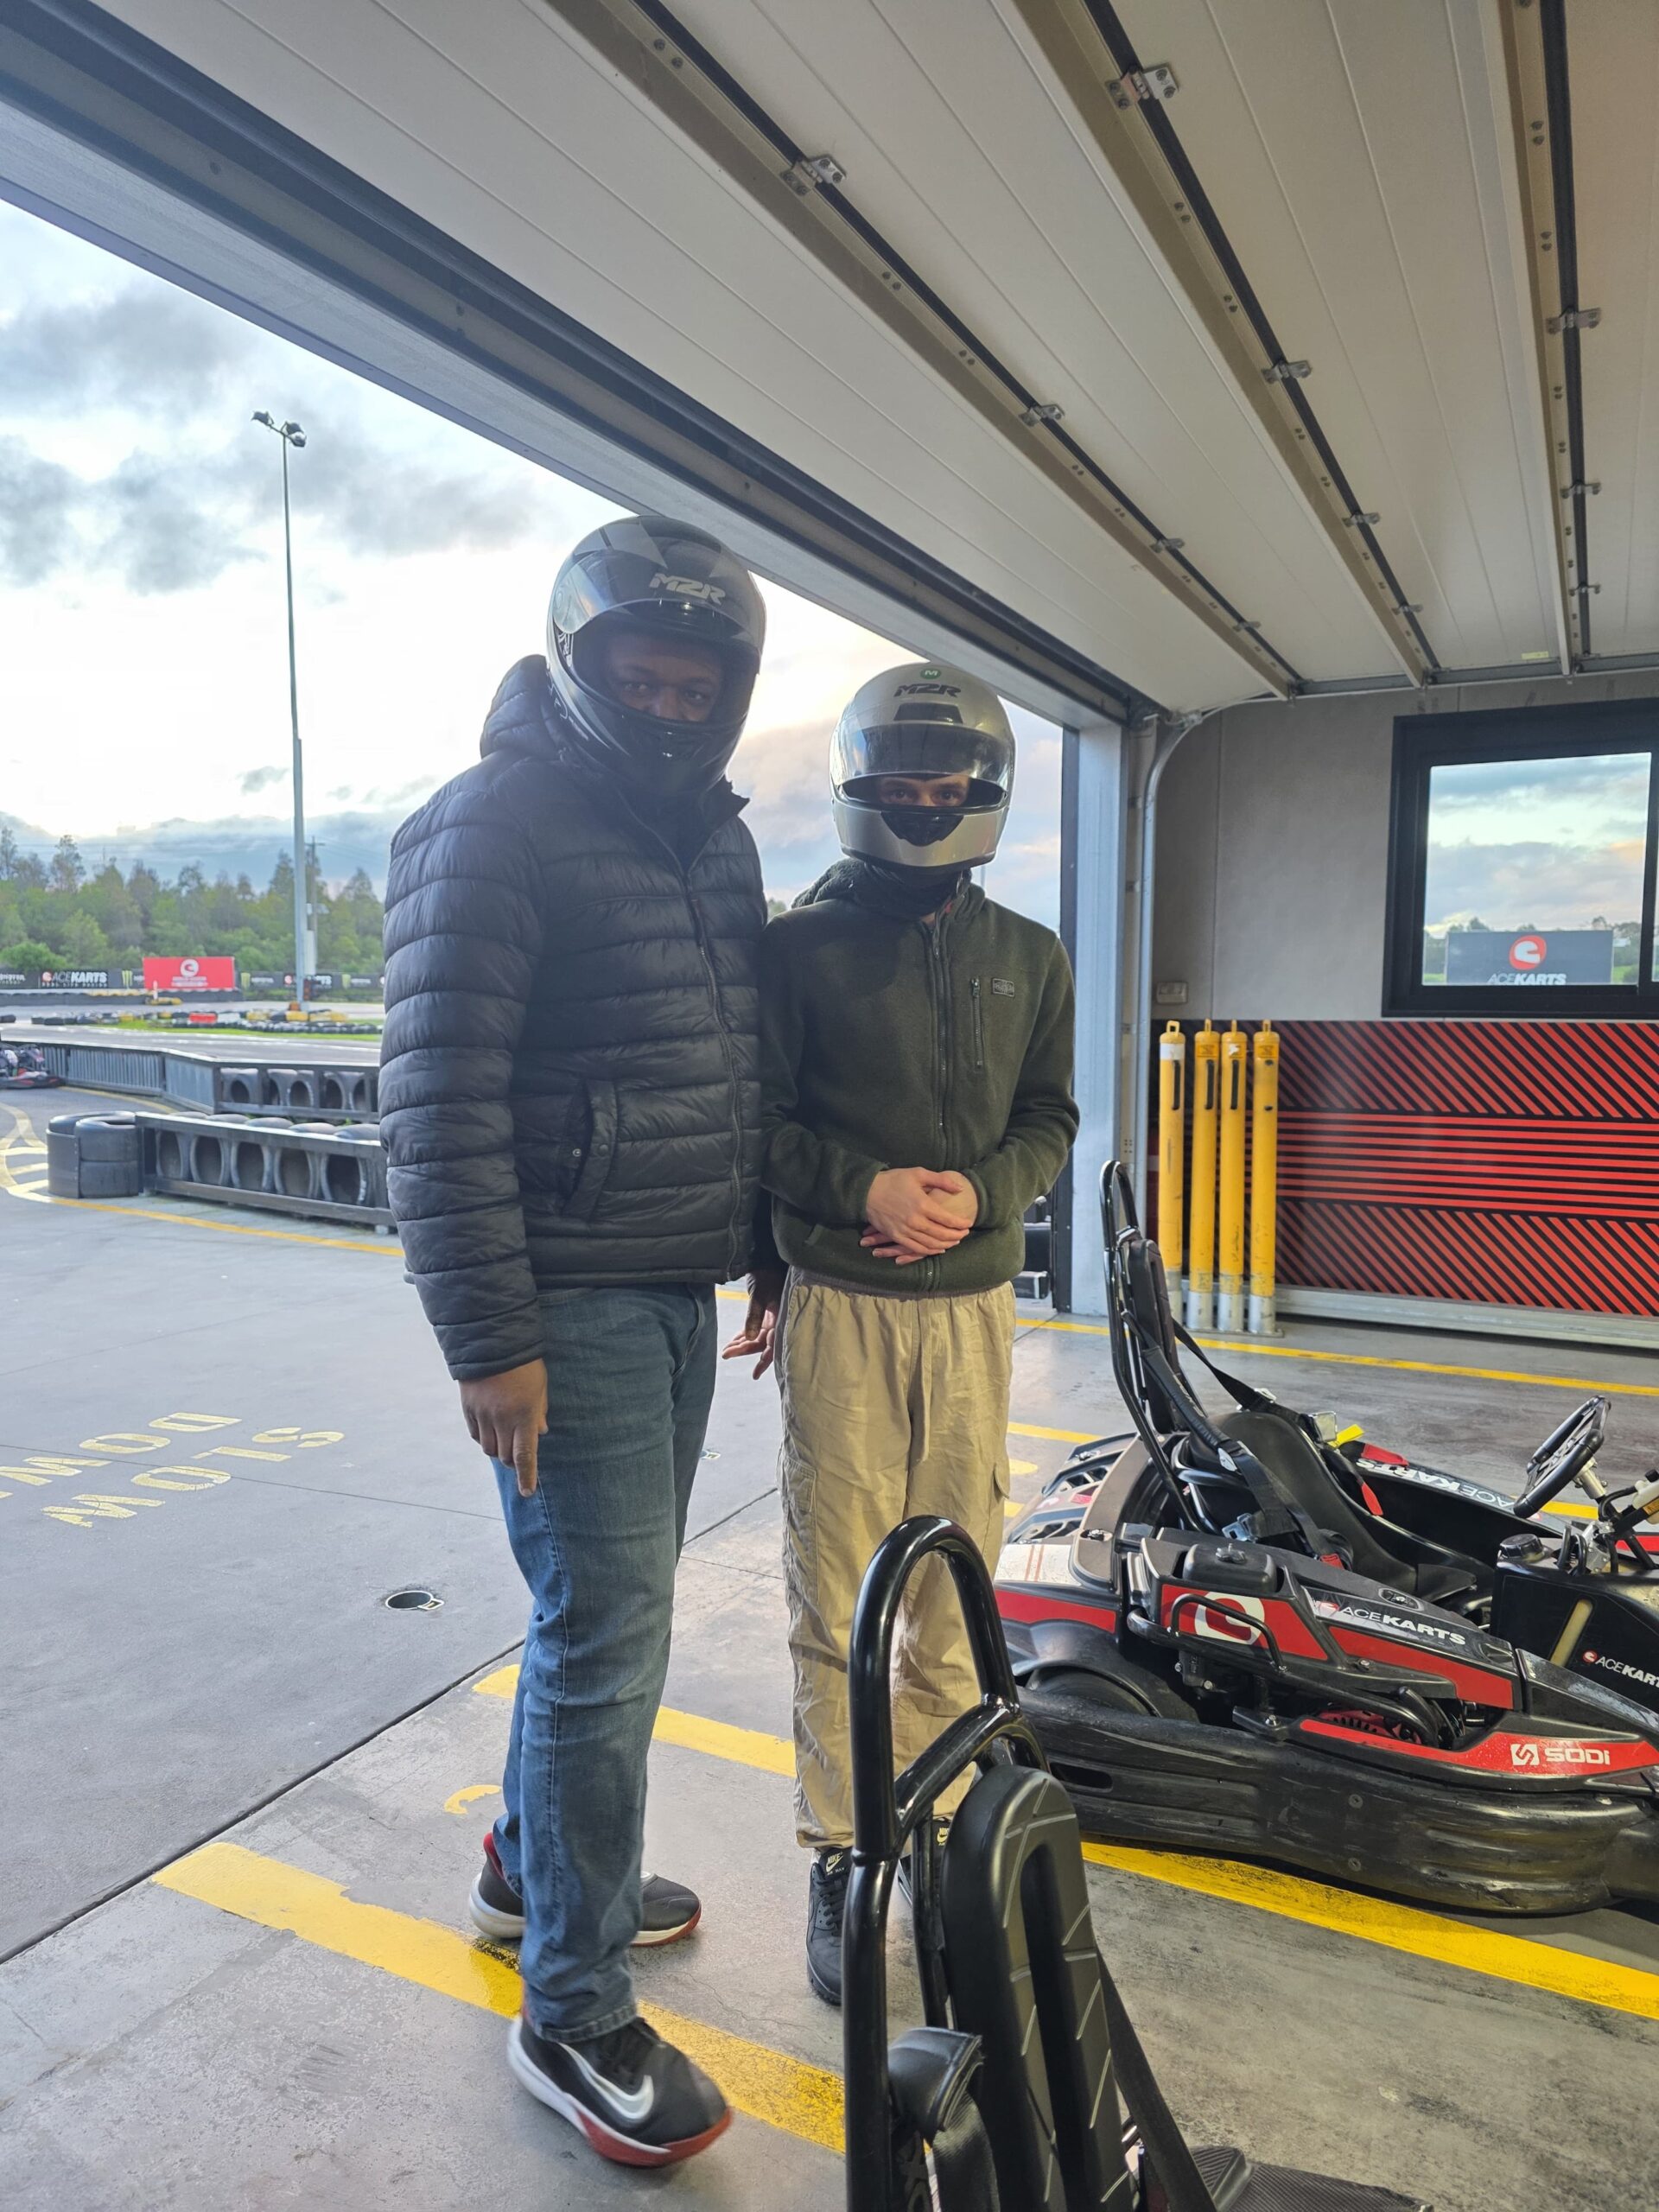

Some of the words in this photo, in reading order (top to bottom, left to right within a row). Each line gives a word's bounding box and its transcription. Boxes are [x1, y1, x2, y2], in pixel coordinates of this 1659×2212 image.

[650, 573, 726, 605] M2R
[893, 683, 962, 698] M2R
[52, 971, 108, 983] ACEKARTS
[1486, 973, 1567, 985] ACEKARTS
[0, 1412, 242, 1498] DOW
[1340, 1606, 1466, 1646] ACEKARTS
[827, 1853, 842, 1865] NIKE
